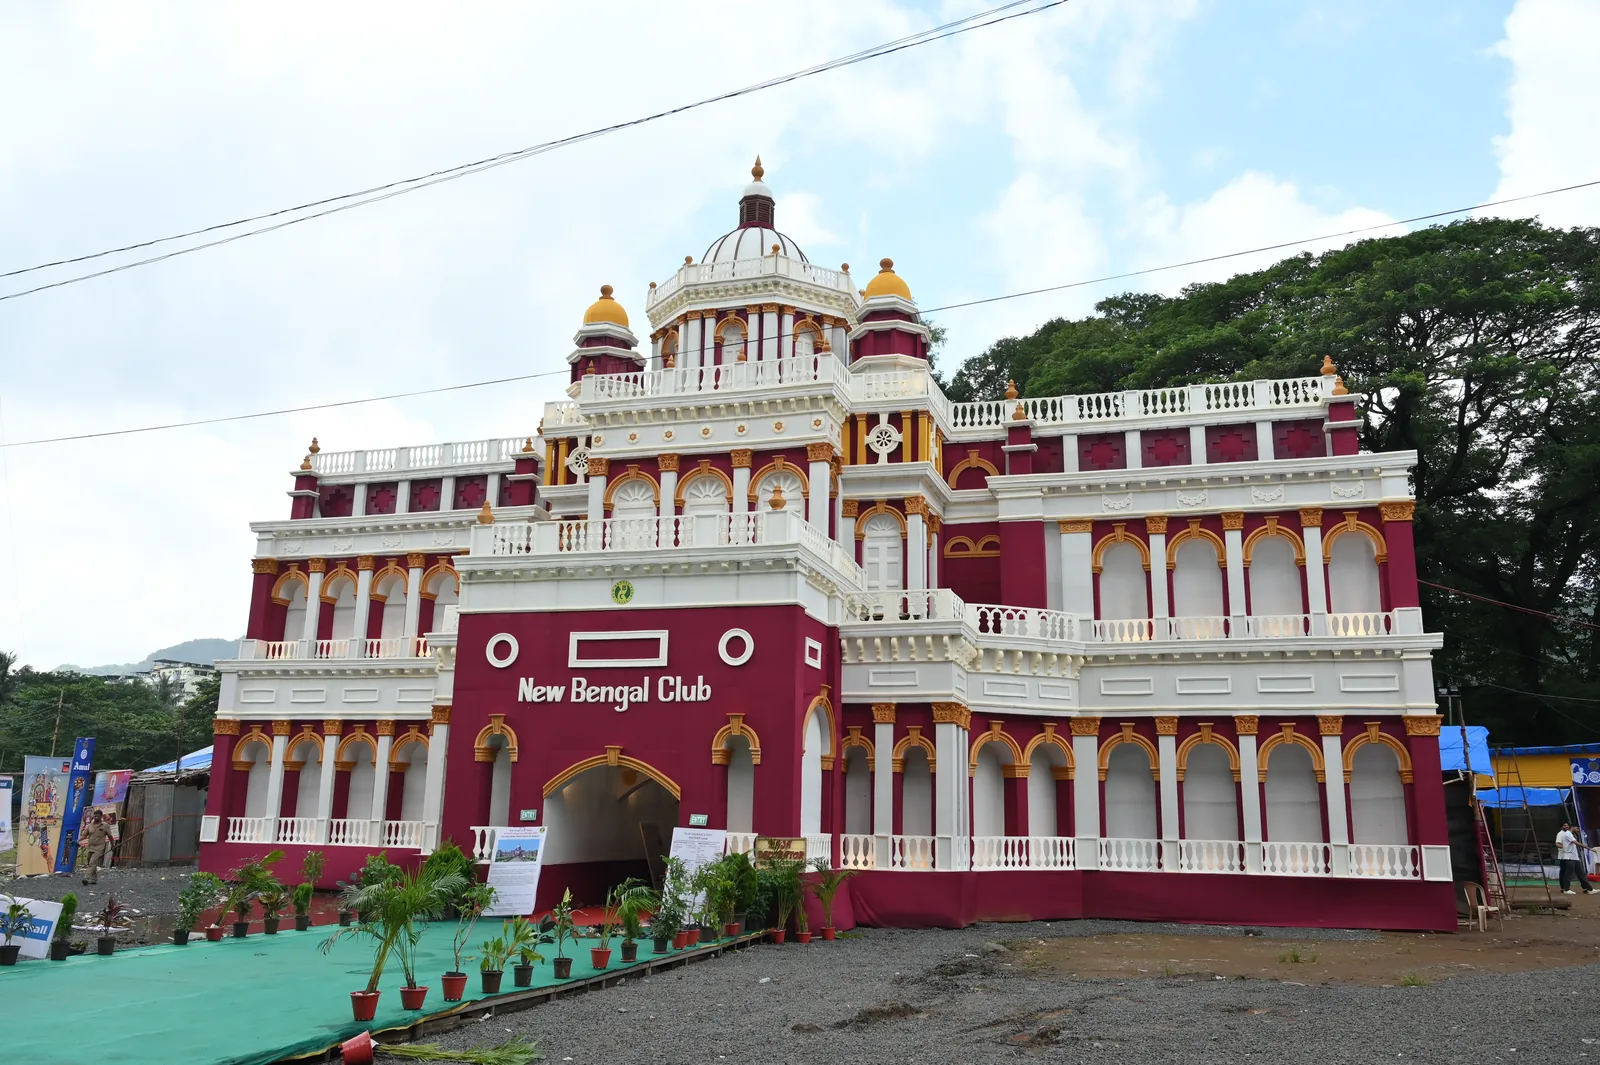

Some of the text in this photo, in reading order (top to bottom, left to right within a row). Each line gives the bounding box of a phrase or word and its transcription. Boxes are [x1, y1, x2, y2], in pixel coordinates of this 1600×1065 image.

[518, 675, 712, 712] New Bengal Club
[521, 811, 536, 819] ENTRY
[691, 814, 707, 824] ENTRY
